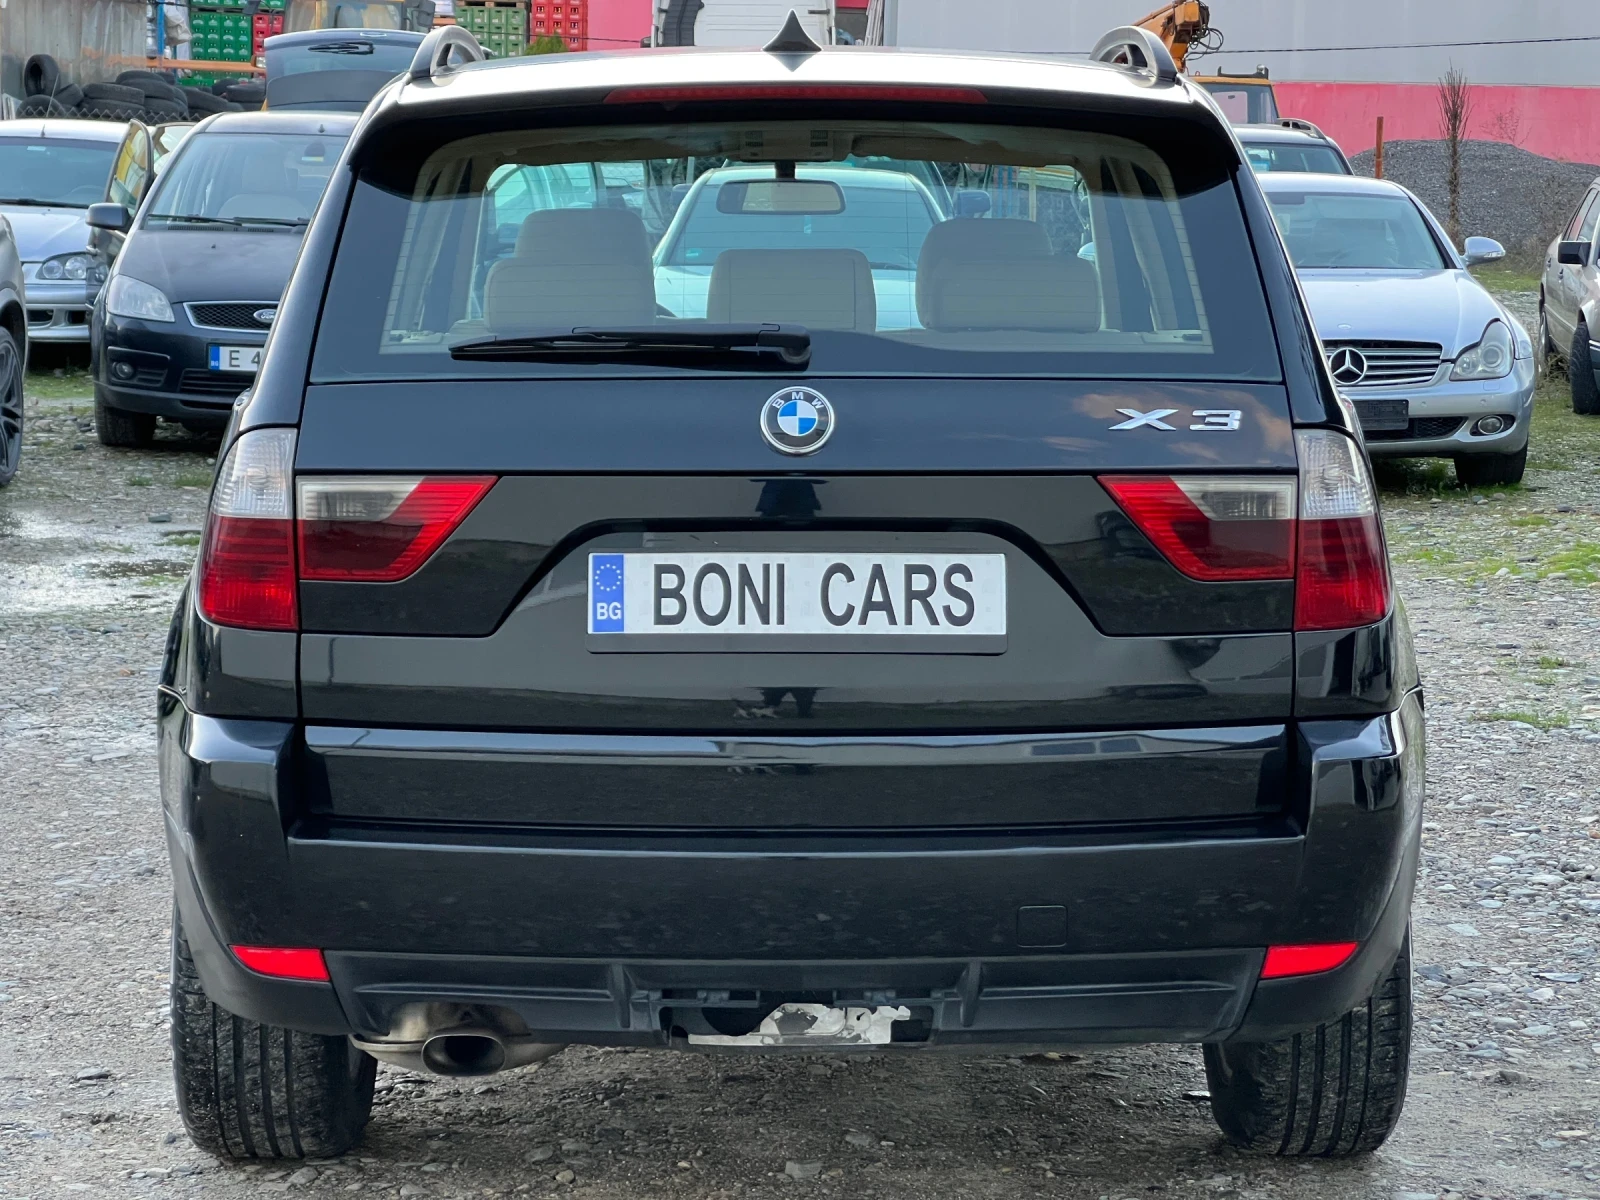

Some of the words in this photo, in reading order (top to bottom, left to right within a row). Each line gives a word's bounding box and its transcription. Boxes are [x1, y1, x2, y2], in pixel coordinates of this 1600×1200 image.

[229, 350, 240, 367] E
[772, 391, 824, 409] BMW
[653, 562, 785, 627] BONI
[820, 562, 975, 627] CARS
[596, 602, 622, 620] BG
